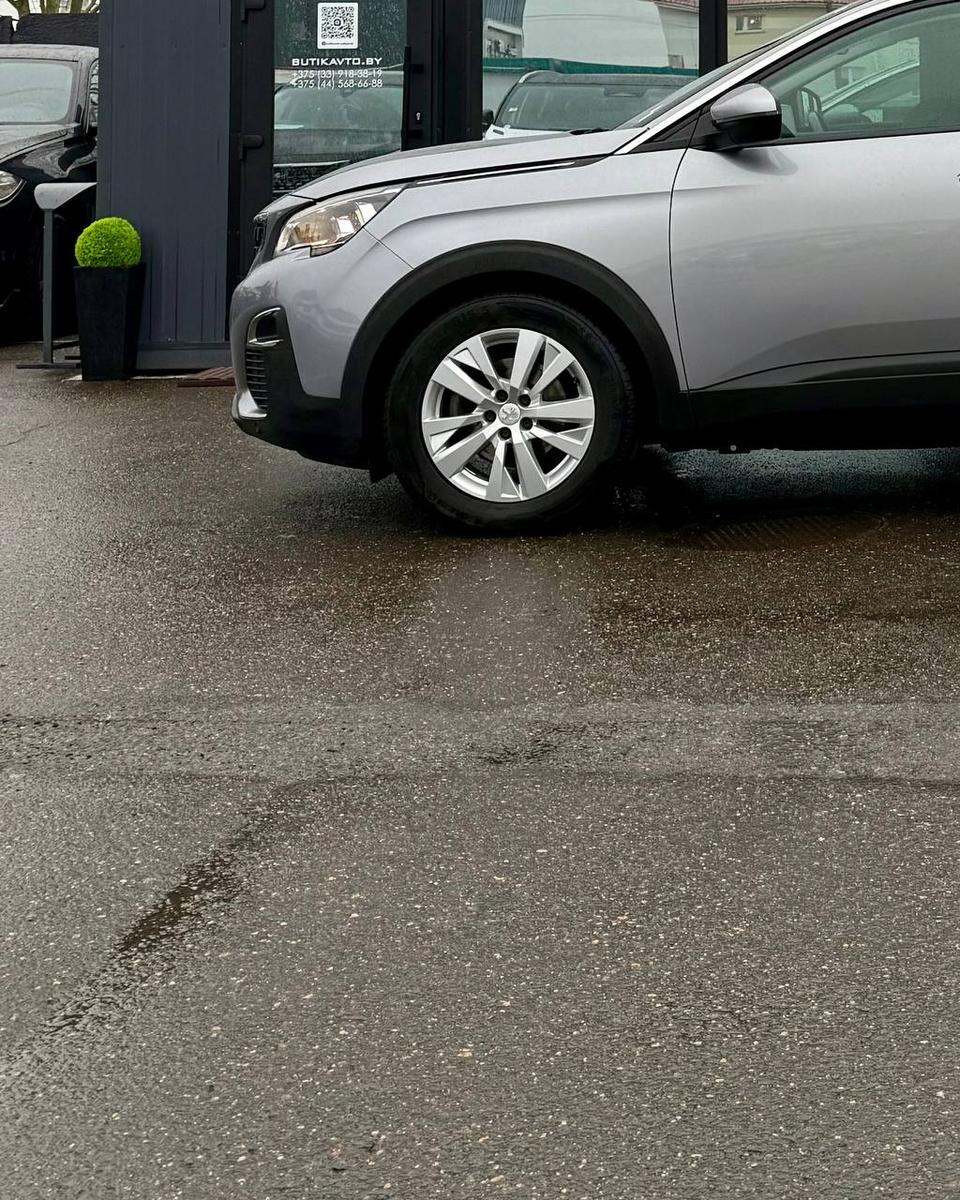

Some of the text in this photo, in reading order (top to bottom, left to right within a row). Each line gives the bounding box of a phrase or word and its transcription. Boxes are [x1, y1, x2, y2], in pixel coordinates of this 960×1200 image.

[292, 57, 383, 66] BUTIKAVTO.BY
[292, 69, 383, 80] +375 (33) 918-38-19
[291, 79, 383, 90] +375 (44) 568-66-88
